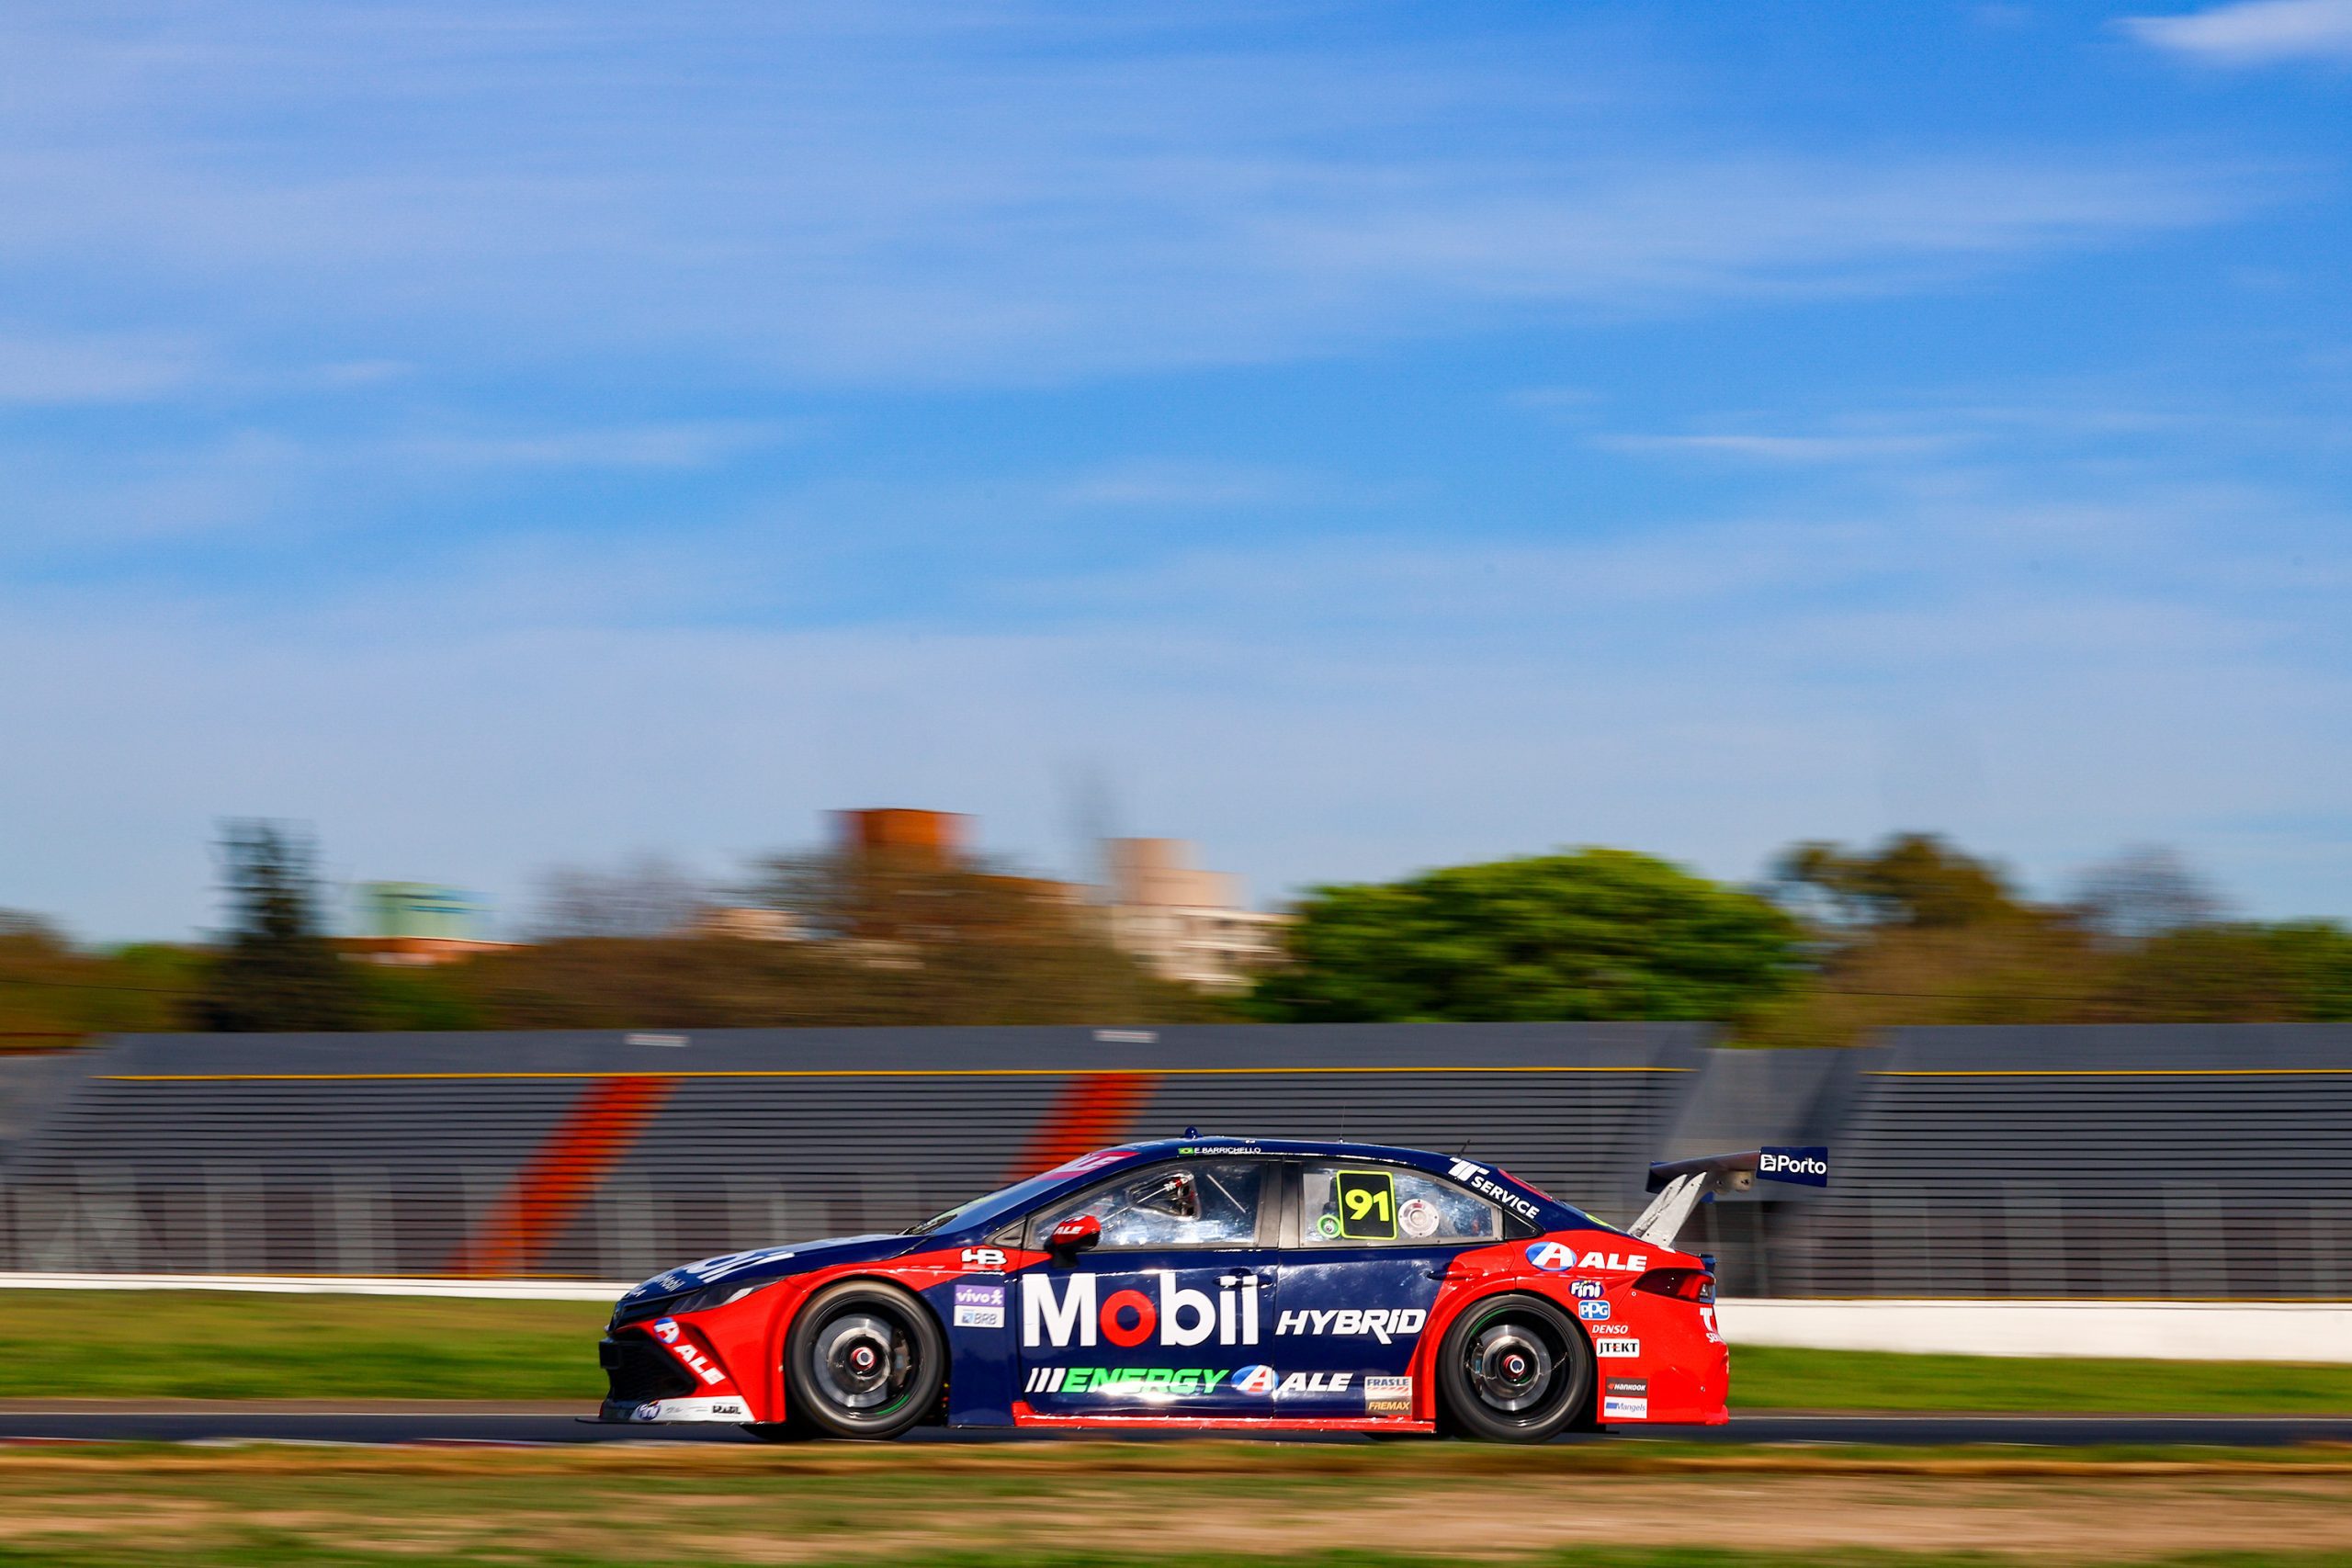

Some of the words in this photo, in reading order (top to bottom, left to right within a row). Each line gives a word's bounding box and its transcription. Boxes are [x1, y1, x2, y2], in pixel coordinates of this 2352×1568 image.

[1202, 1146, 1261, 1155] BARRICHELLO
[1777, 1155, 1827, 1175] Porto
[1345, 1189, 1390, 1222] 91
[1471, 1175, 1541, 1220] SERVICE
[1054, 1225, 1084, 1235] ALE
[1577, 1251, 1647, 1272] ALE
[956, 1289, 990, 1303] vivo
[1570, 1280, 1602, 1298] Fini
[1022, 1272, 1260, 1348] Mobil
[1580, 1302, 1609, 1319] PPG
[1275, 1308, 1427, 1345] HYBRID
[1591, 1324, 1629, 1335] DENSO
[1599, 1342, 1638, 1355] JTEKT
[673, 1344, 727, 1386] ALE
[1277, 1372, 1354, 1393] ALE
[1368, 1401, 1410, 1411] FREMAX
